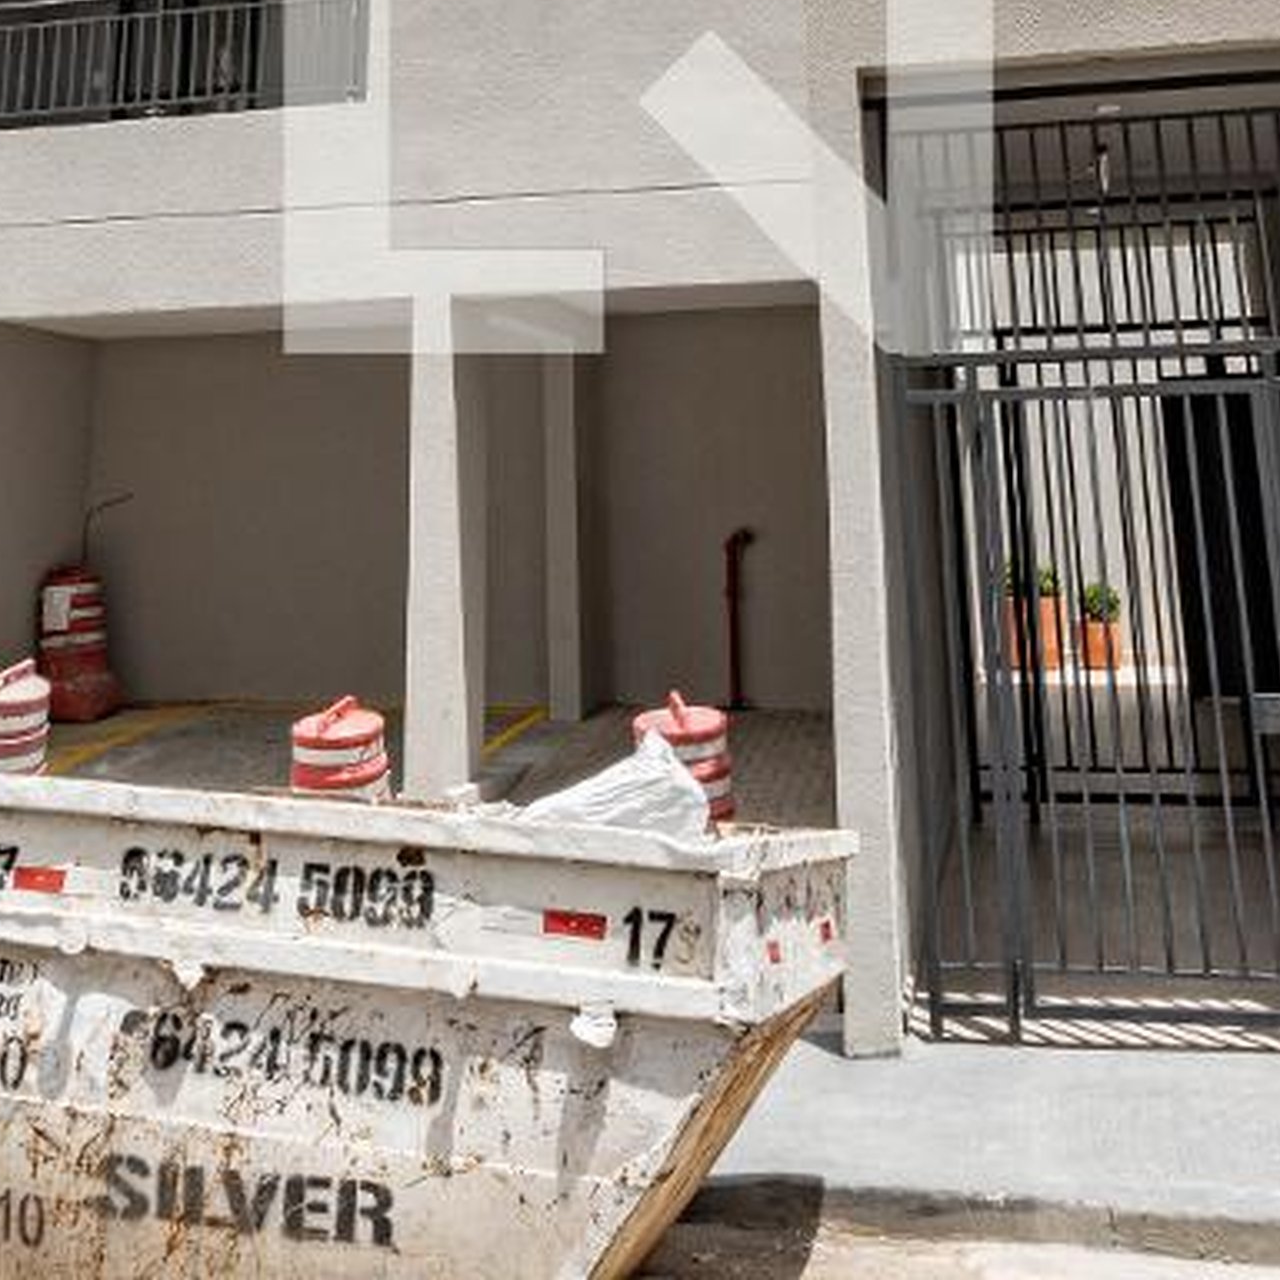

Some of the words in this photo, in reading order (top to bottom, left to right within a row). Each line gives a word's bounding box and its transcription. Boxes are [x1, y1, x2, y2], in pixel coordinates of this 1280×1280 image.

[296, 861, 435, 929] 5099
[623, 906, 677, 970] 17
[306, 1030, 443, 1107] 5099
[100, 1151, 398, 1251] SILVER
